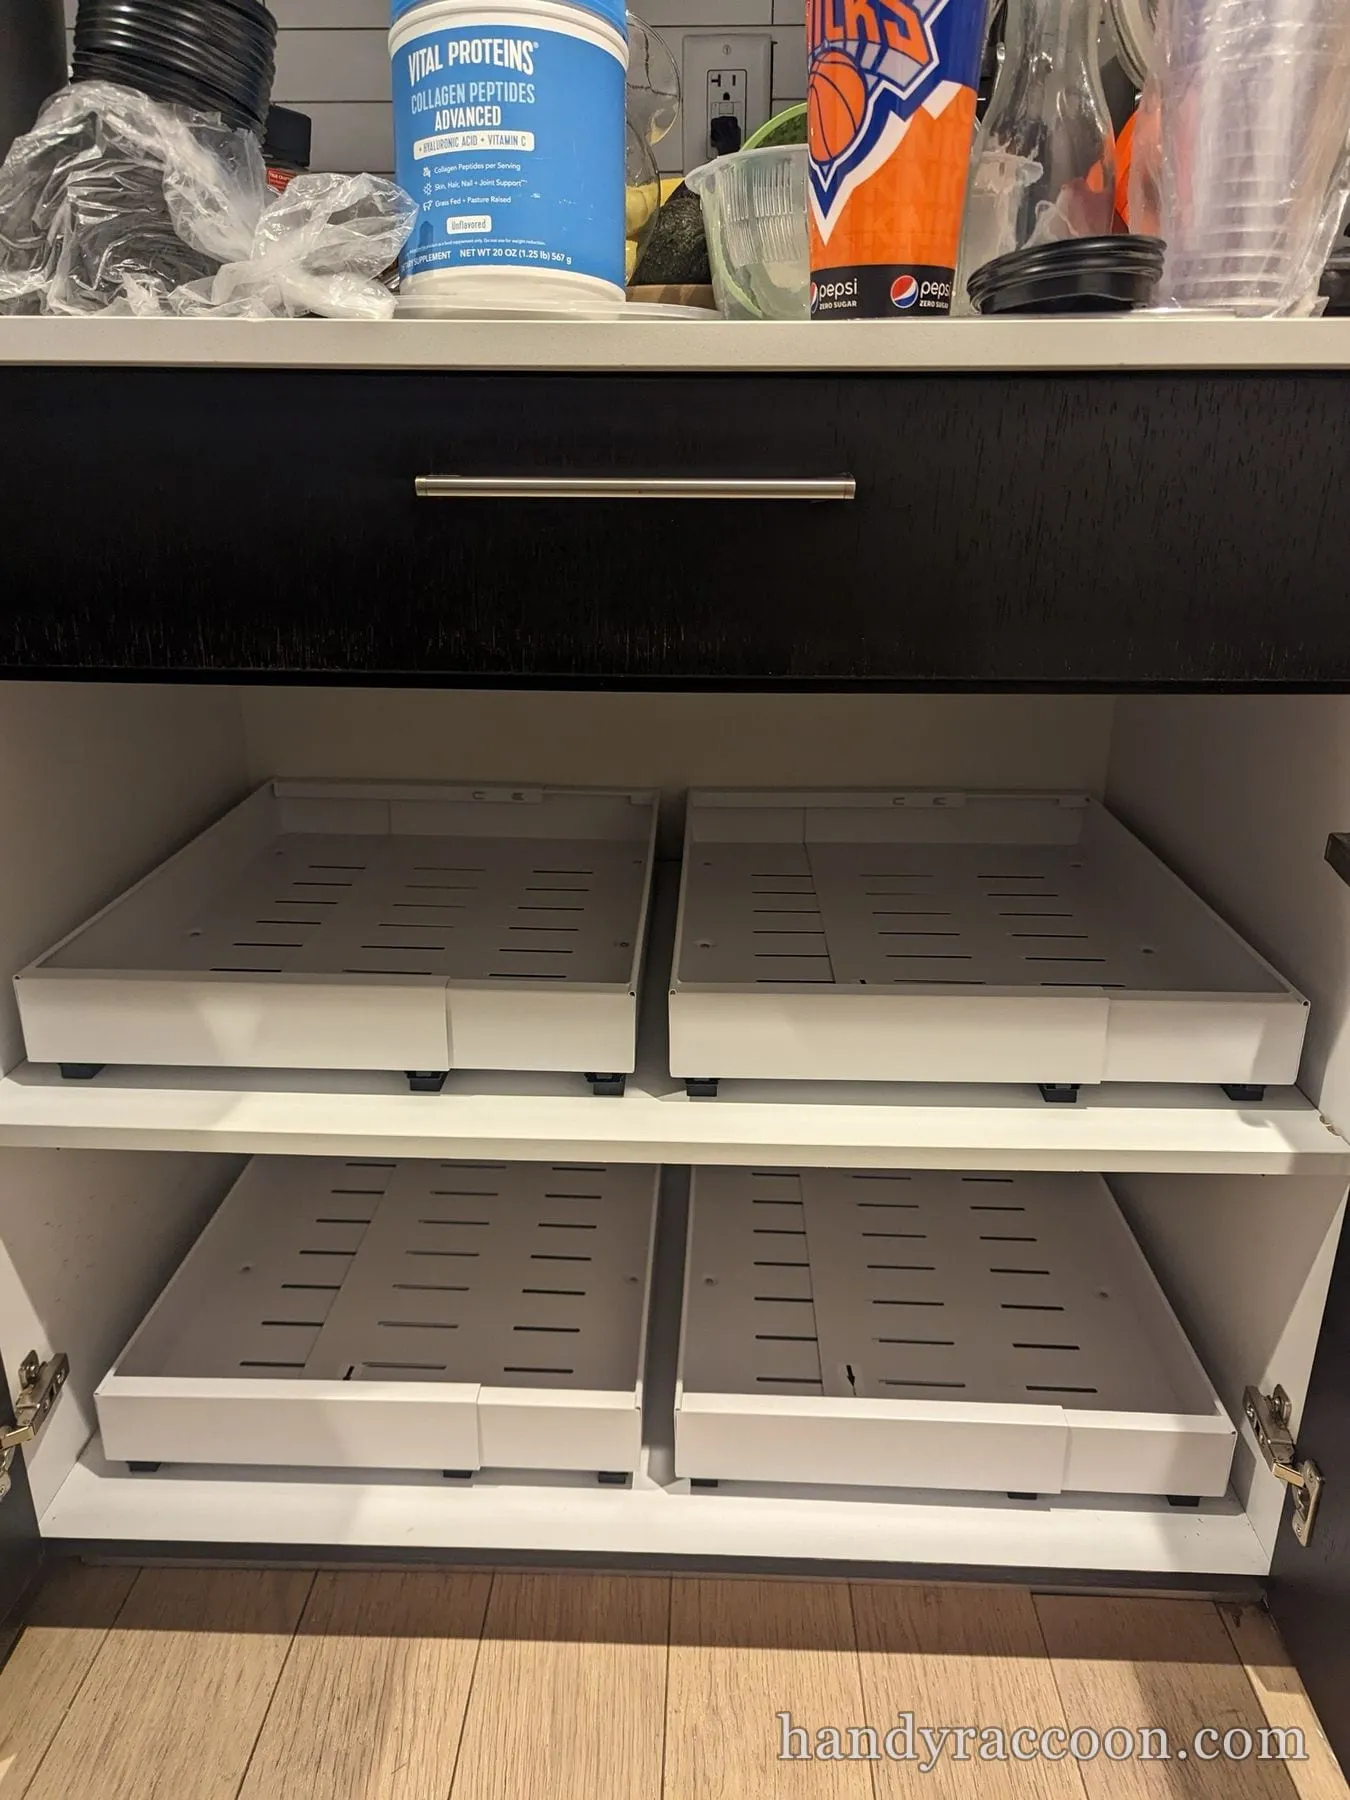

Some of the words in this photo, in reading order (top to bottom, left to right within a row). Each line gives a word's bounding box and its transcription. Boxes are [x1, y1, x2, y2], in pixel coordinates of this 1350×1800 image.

[408, 45, 443, 87] VITAL
[411, 82, 466, 115] COLLAGEN
[469, 81, 536, 104] PEPTIDES
[434, 105, 502, 131] ADVANCED
[423, 136, 459, 153] HYALURONIC
[461, 134, 478, 147] ACID
[487, 134, 519, 146] VITAMIN
[521, 135, 527, 147] C
[433, 165, 458, 175] Collagen
[458, 162, 484, 172] Peptides
[497, 161, 521, 172] Serving
[479, 178, 495, 187] Joint
[467, 196, 490, 204] Pasture
[490, 195, 512, 204] Raised
[451, 219, 487, 231] Unflavored
[413, 250, 452, 265] SUPPLEMENT
[459, 248, 475, 258] NET
[477, 247, 492, 257] WT
[493, 248, 503, 257] 20
[504, 248, 517, 257] OZ
[519, 249, 539, 259] (1.25
[540, 250, 550, 261] lb)
[551, 252, 565, 262] 567
[566, 256, 572, 265] g
[819, 278, 858, 301] pepsi
[819, 300, 833, 310] ZERO
[834, 300, 858, 308] SUGAR
[919, 300, 936, 308] ZERO
